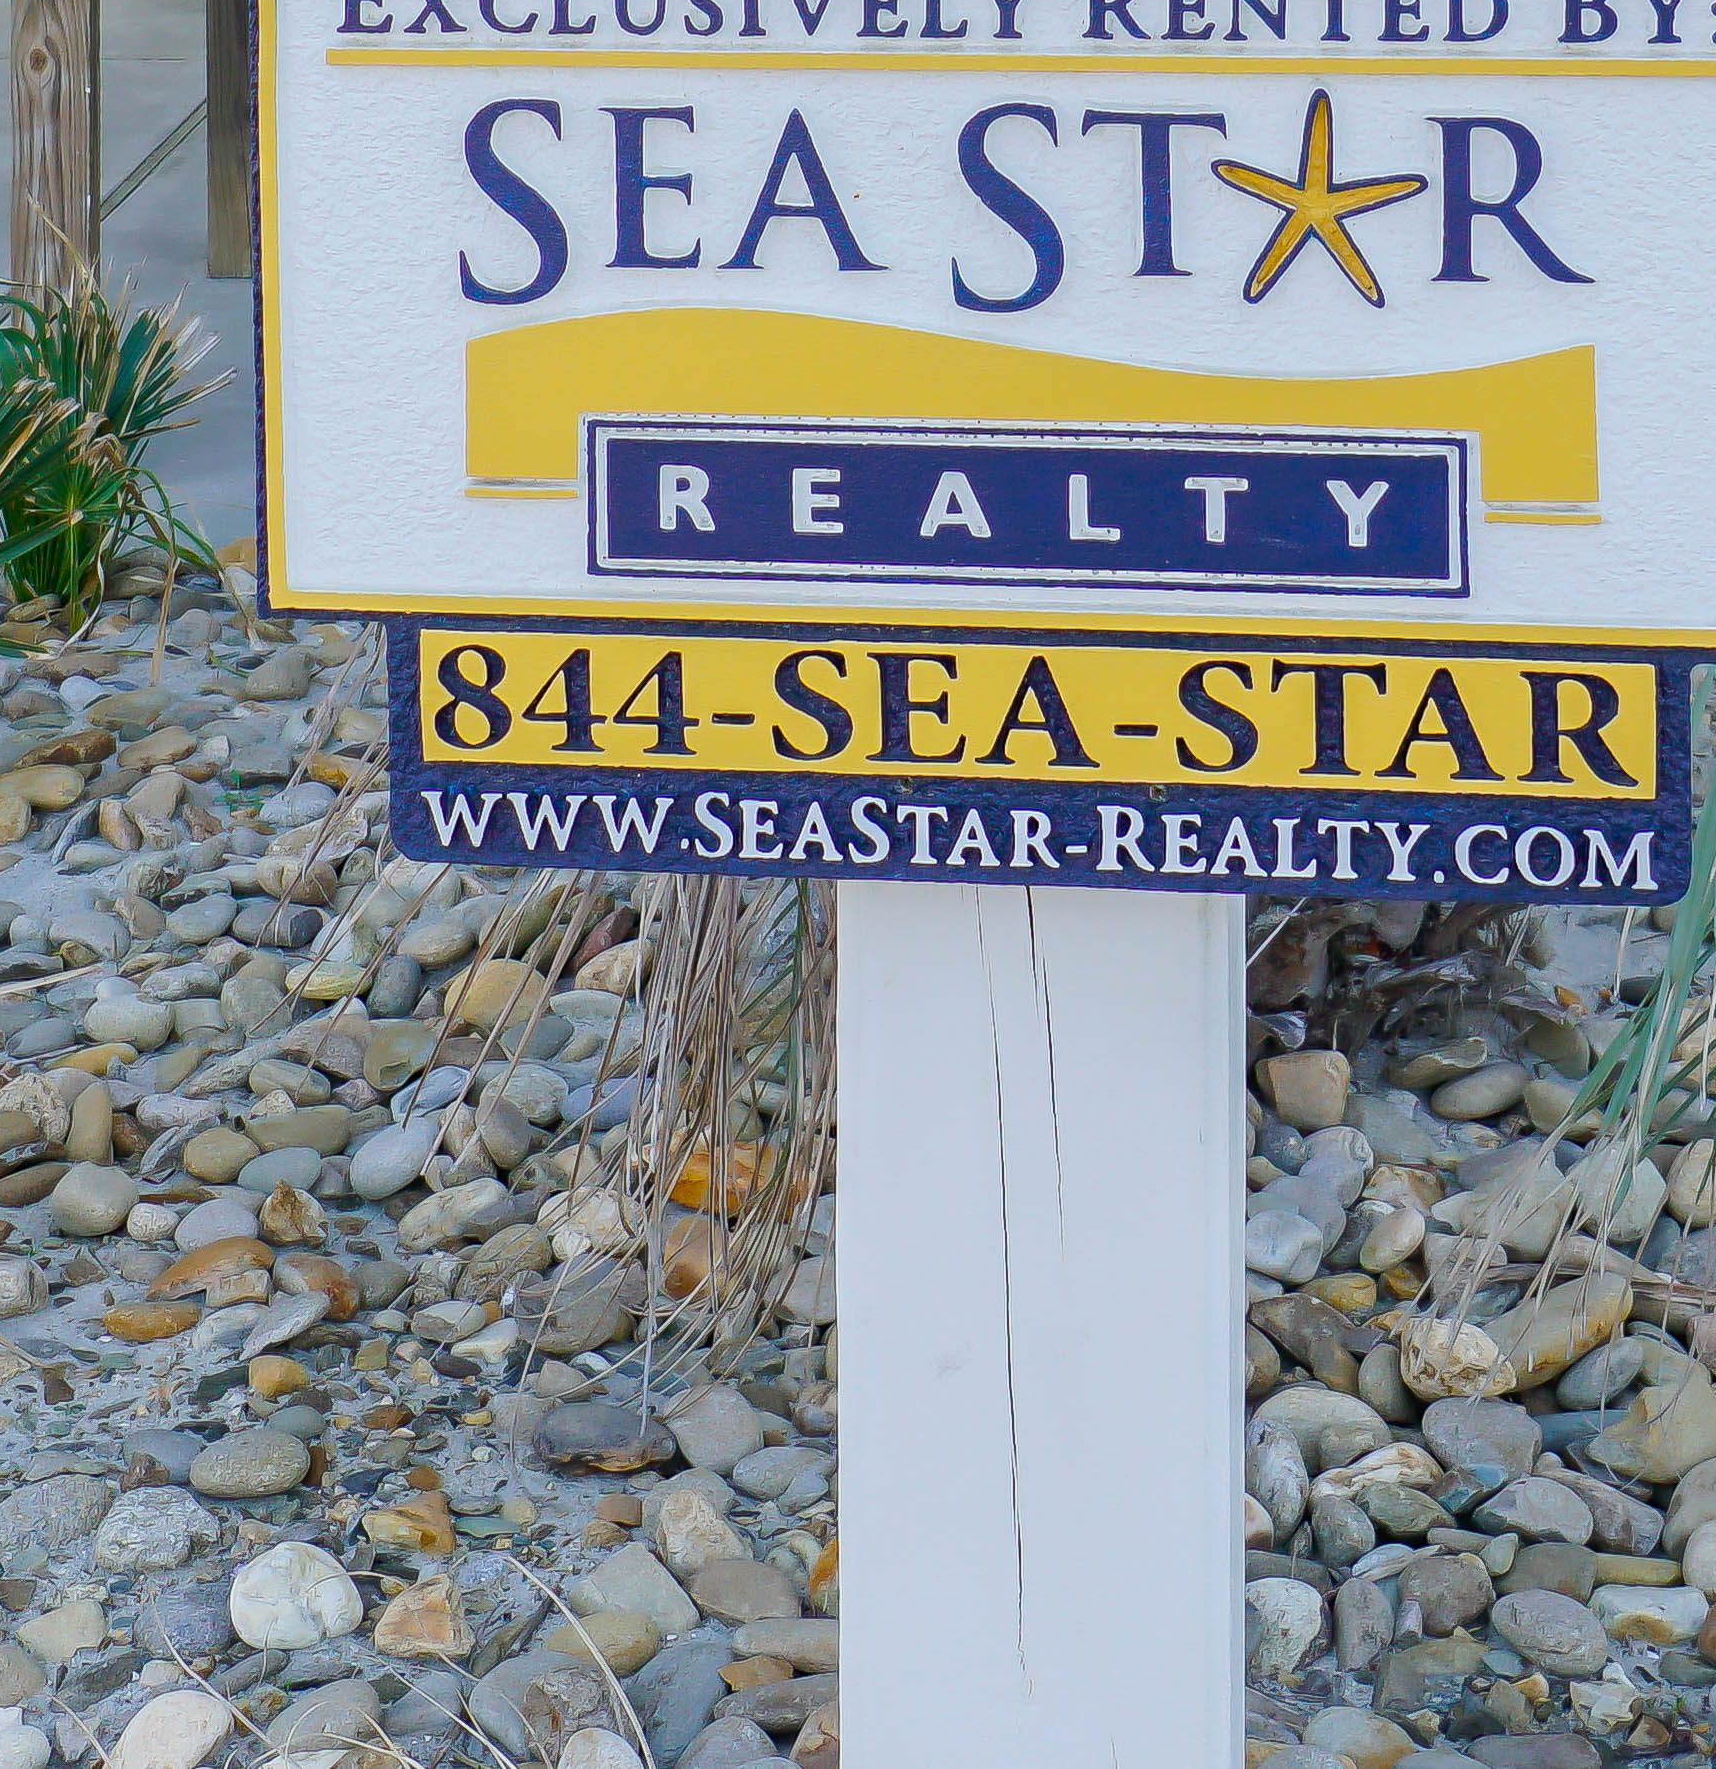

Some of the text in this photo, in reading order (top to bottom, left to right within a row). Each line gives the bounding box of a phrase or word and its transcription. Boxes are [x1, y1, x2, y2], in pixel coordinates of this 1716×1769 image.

[458, 97, 888, 307] SEA
[657, 463, 1391, 549] REALTY
[434, 644, 1647, 789] 844-SEA-STAR
[421, 789, 1659, 890] WWW.SEASTAR-REALTY.COM
